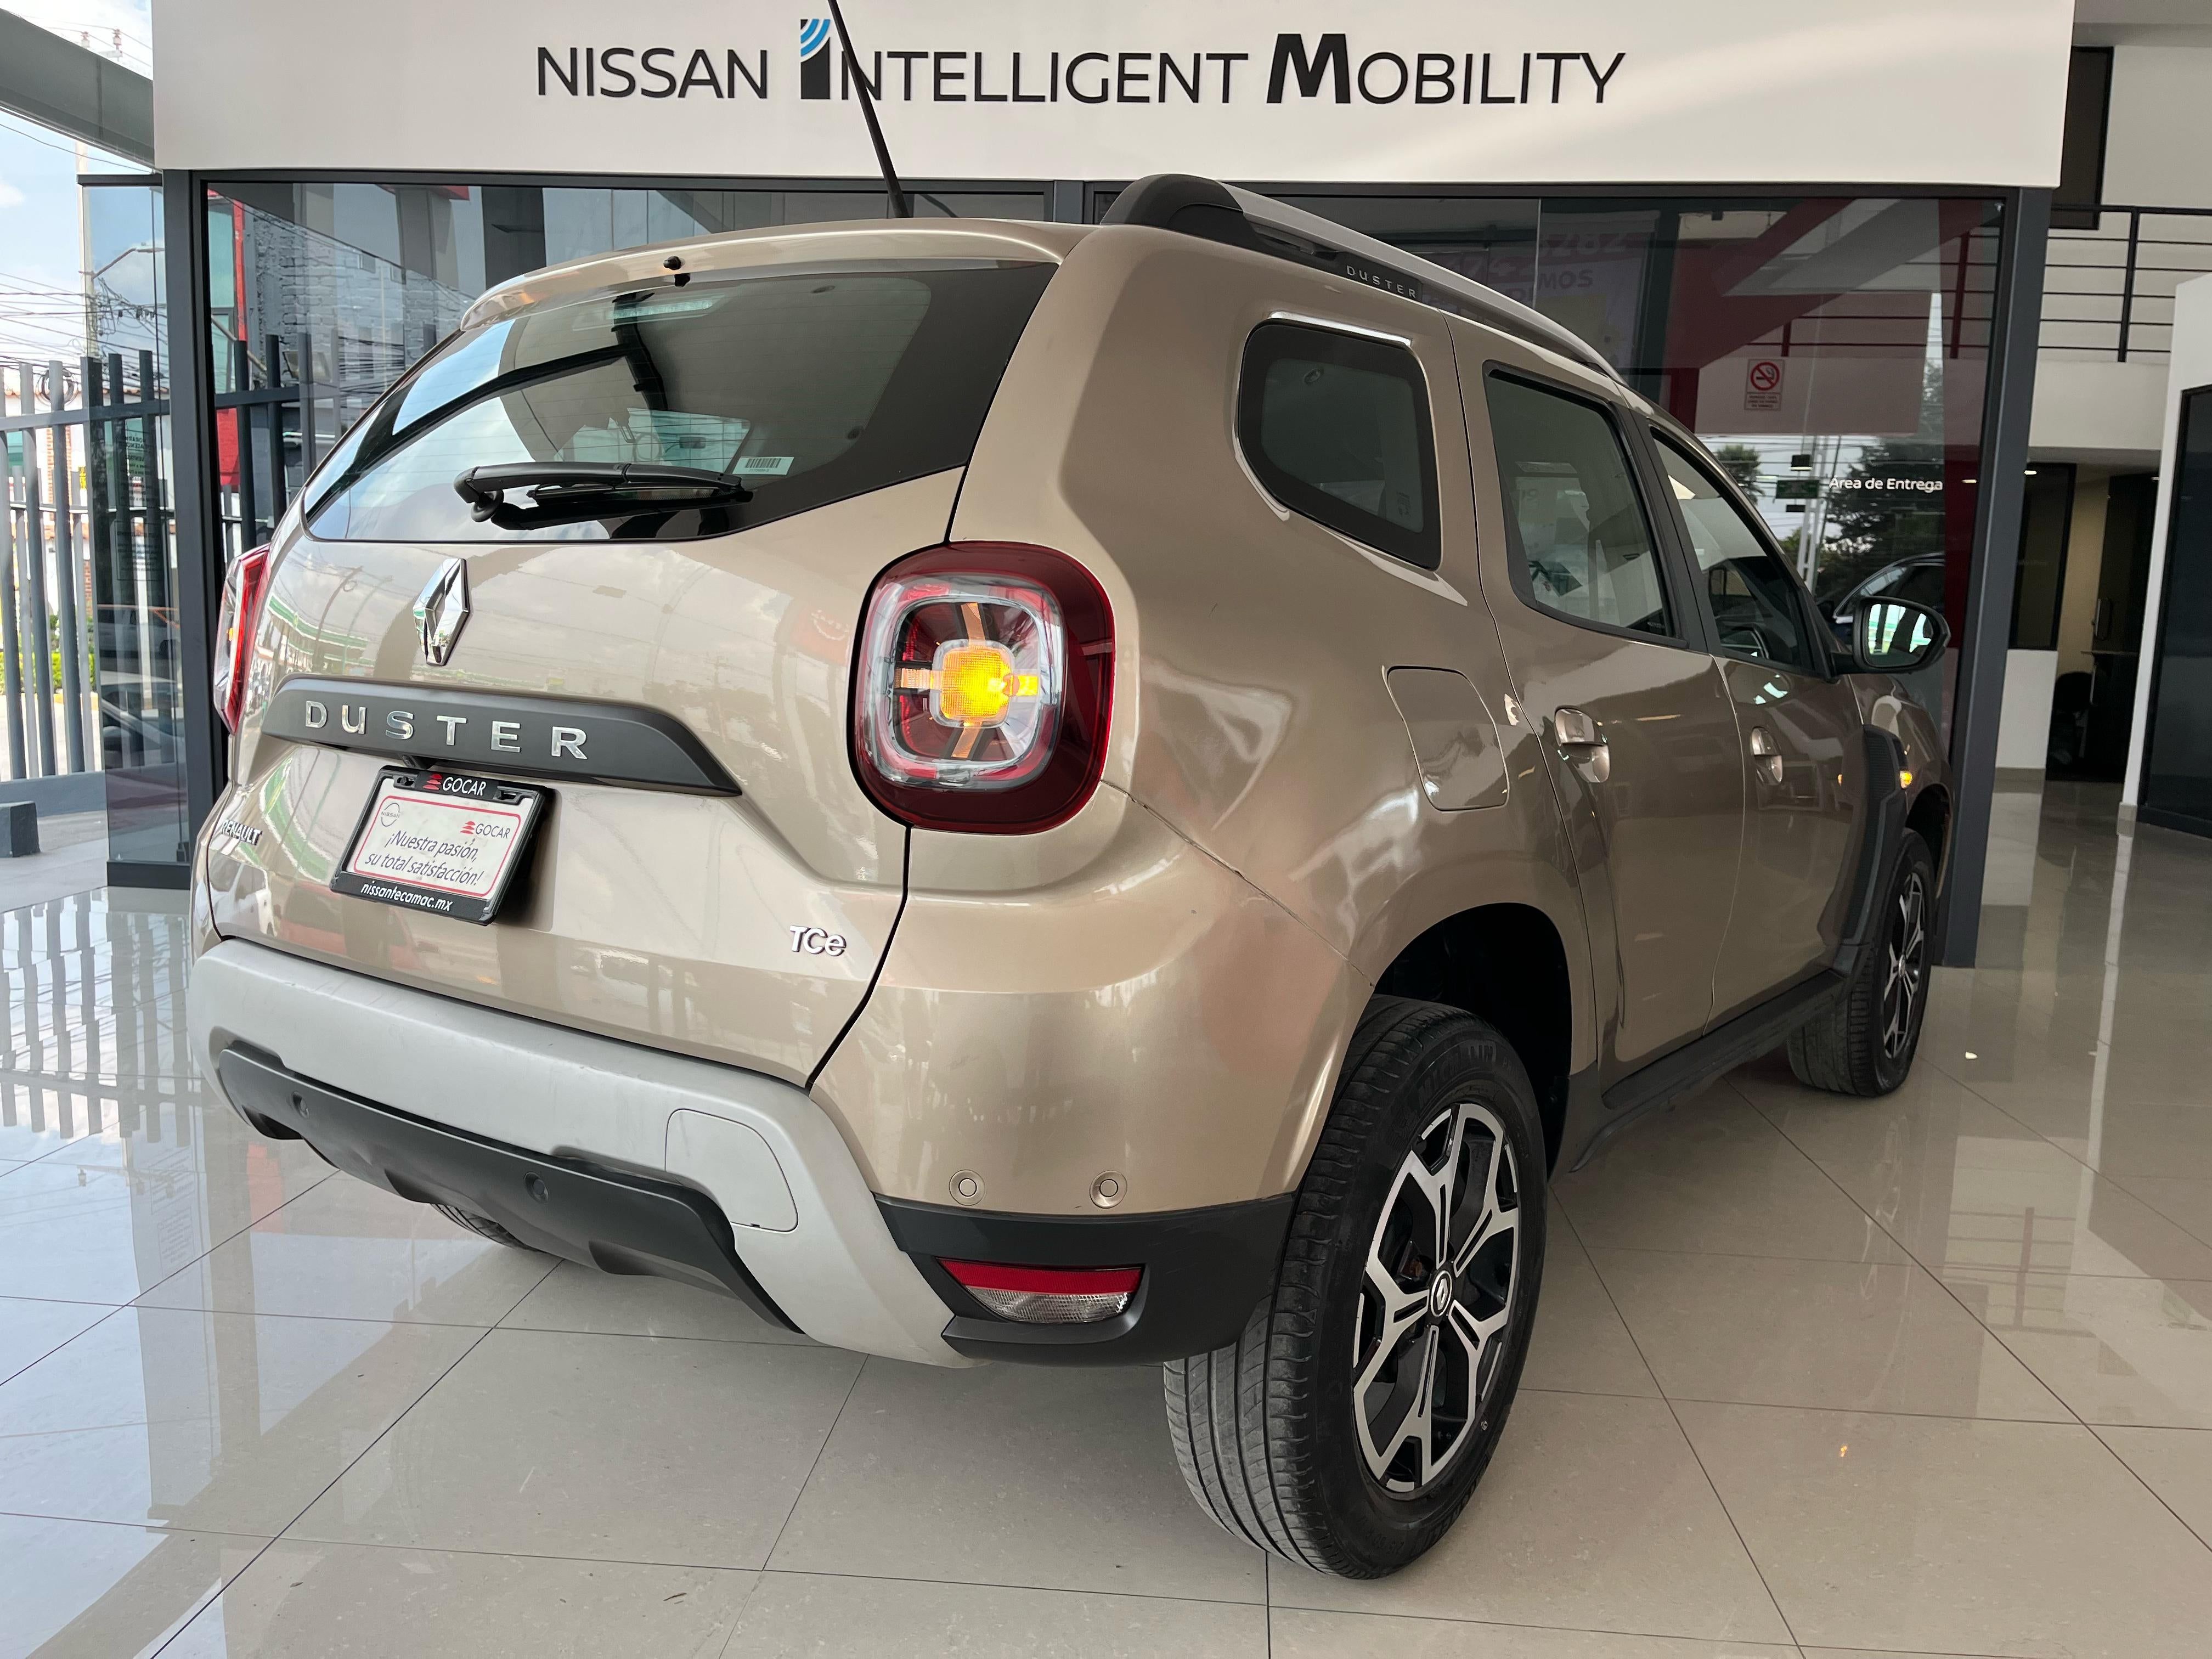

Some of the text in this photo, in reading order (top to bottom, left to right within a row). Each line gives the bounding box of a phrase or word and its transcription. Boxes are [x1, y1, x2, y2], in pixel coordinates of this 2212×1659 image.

[537, 19, 1626, 105] NISSAN INTELLIGENT MOBILITY
[1346, 265, 1416, 298] DUSTER
[1865, 477, 1883, 489] de
[1887, 478, 1943, 493] Entrega
[305, 700, 588, 759] DUSTER
[442, 776, 487, 796] GOCAR
[221, 819, 262, 845] RENAULT
[385, 830, 479, 863] ¡Nuestra pasión,
[475, 823, 510, 839] GOCAR
[365, 853, 484, 886] su total satisfacción!
[360, 881, 454, 911] nissantecamac.mx
[790, 926, 847, 957] TCe
